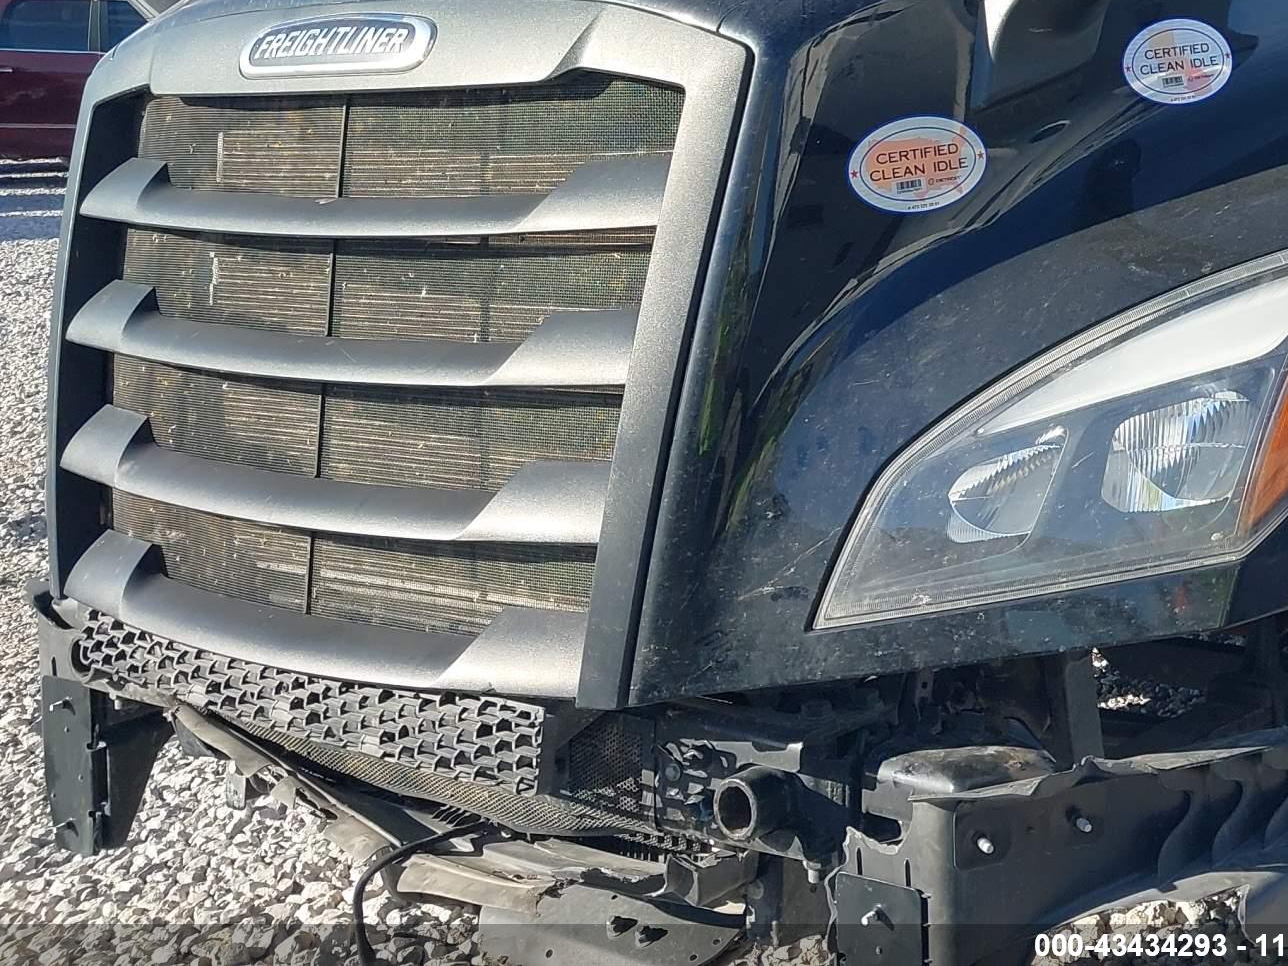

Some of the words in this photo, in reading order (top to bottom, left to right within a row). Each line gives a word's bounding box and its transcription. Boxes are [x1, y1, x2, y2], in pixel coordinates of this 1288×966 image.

[254, 26, 408, 60] FREIGHTLINER
[1144, 42, 1210, 60] CERTIFIED
[1140, 60, 1185, 76] CLEAN
[1190, 55, 1219, 69] IDLE
[876, 143, 959, 165] CERTIFIED
[869, 163, 926, 182] CLEAN
[933, 157, 969, 173] IDLE
